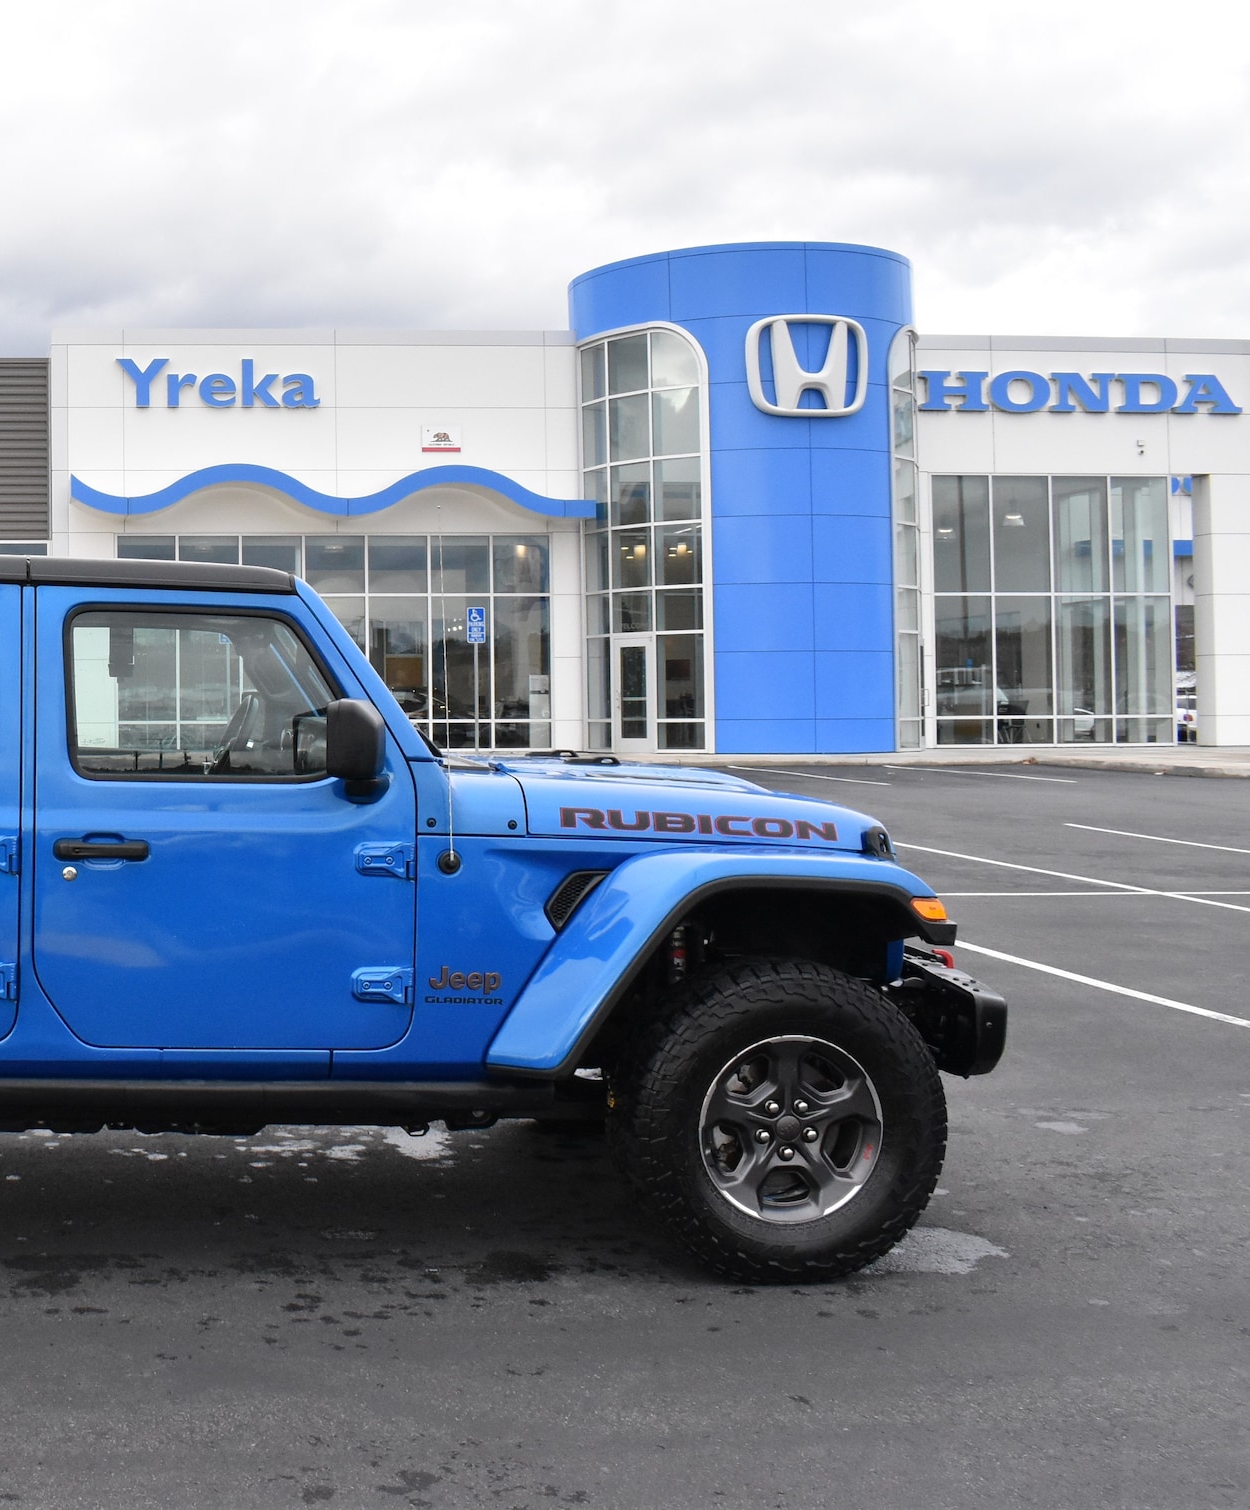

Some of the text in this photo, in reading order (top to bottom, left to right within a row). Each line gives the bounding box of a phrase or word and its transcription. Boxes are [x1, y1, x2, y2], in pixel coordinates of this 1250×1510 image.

[115, 358, 321, 408] Yreka
[918, 370, 1243, 414] HONDA
[559, 806, 839, 842] RUBICON
[429, 966, 502, 995] Jeep
[424, 996, 503, 1006] GLADIATOR
